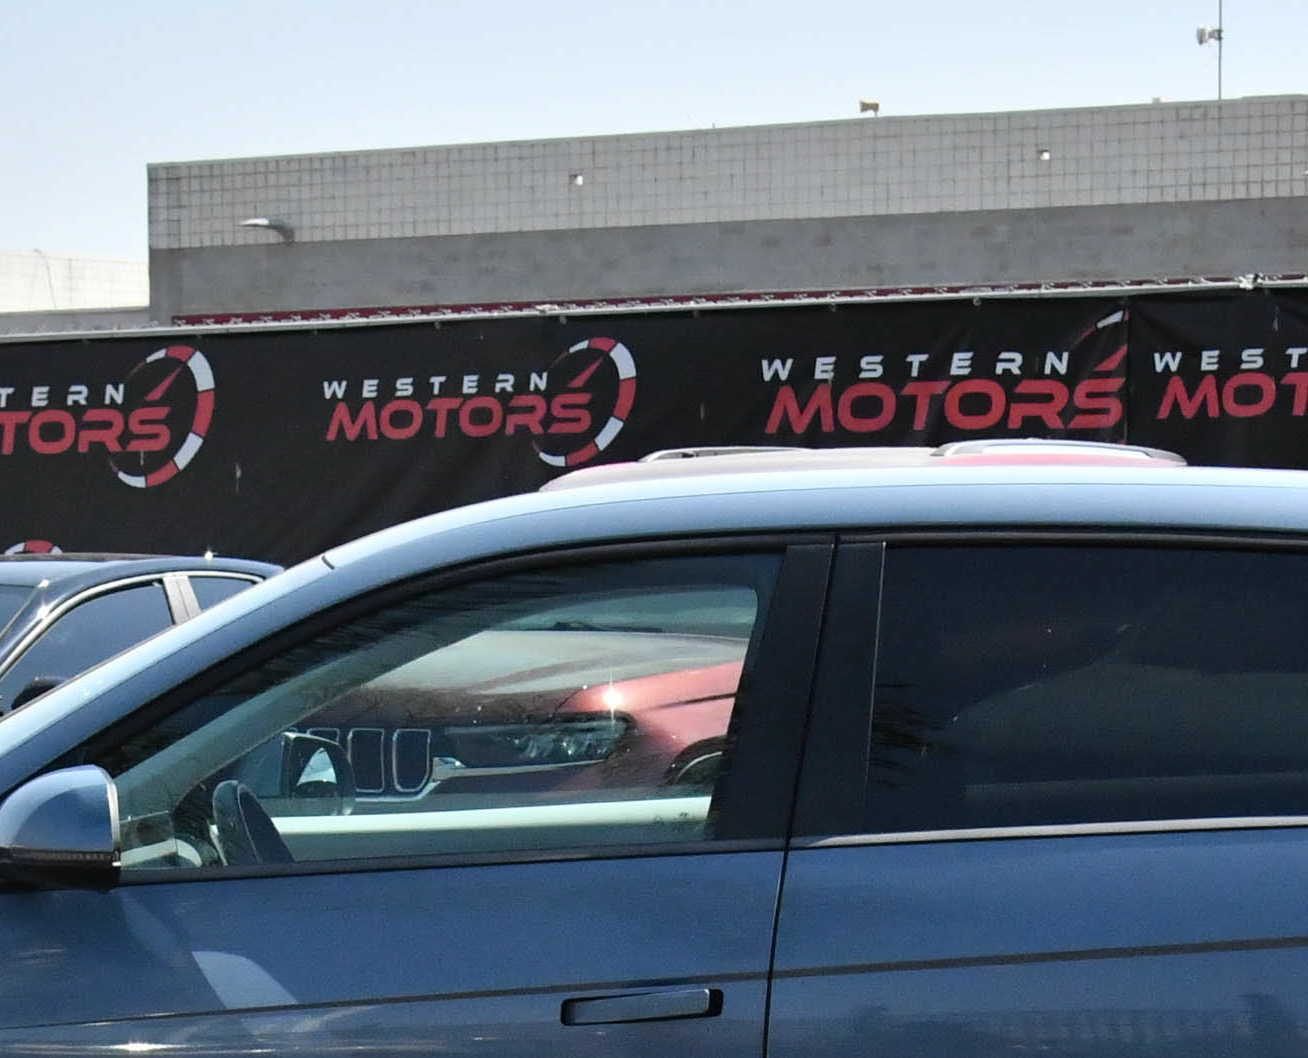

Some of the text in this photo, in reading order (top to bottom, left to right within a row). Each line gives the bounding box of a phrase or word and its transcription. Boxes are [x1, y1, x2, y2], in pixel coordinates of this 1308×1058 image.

[323, 372, 548, 399] WESTERN
[762, 351, 1069, 382] WESTERN
[326, 393, 592, 441] MOTORS
[764, 378, 1125, 434] MOTORS
